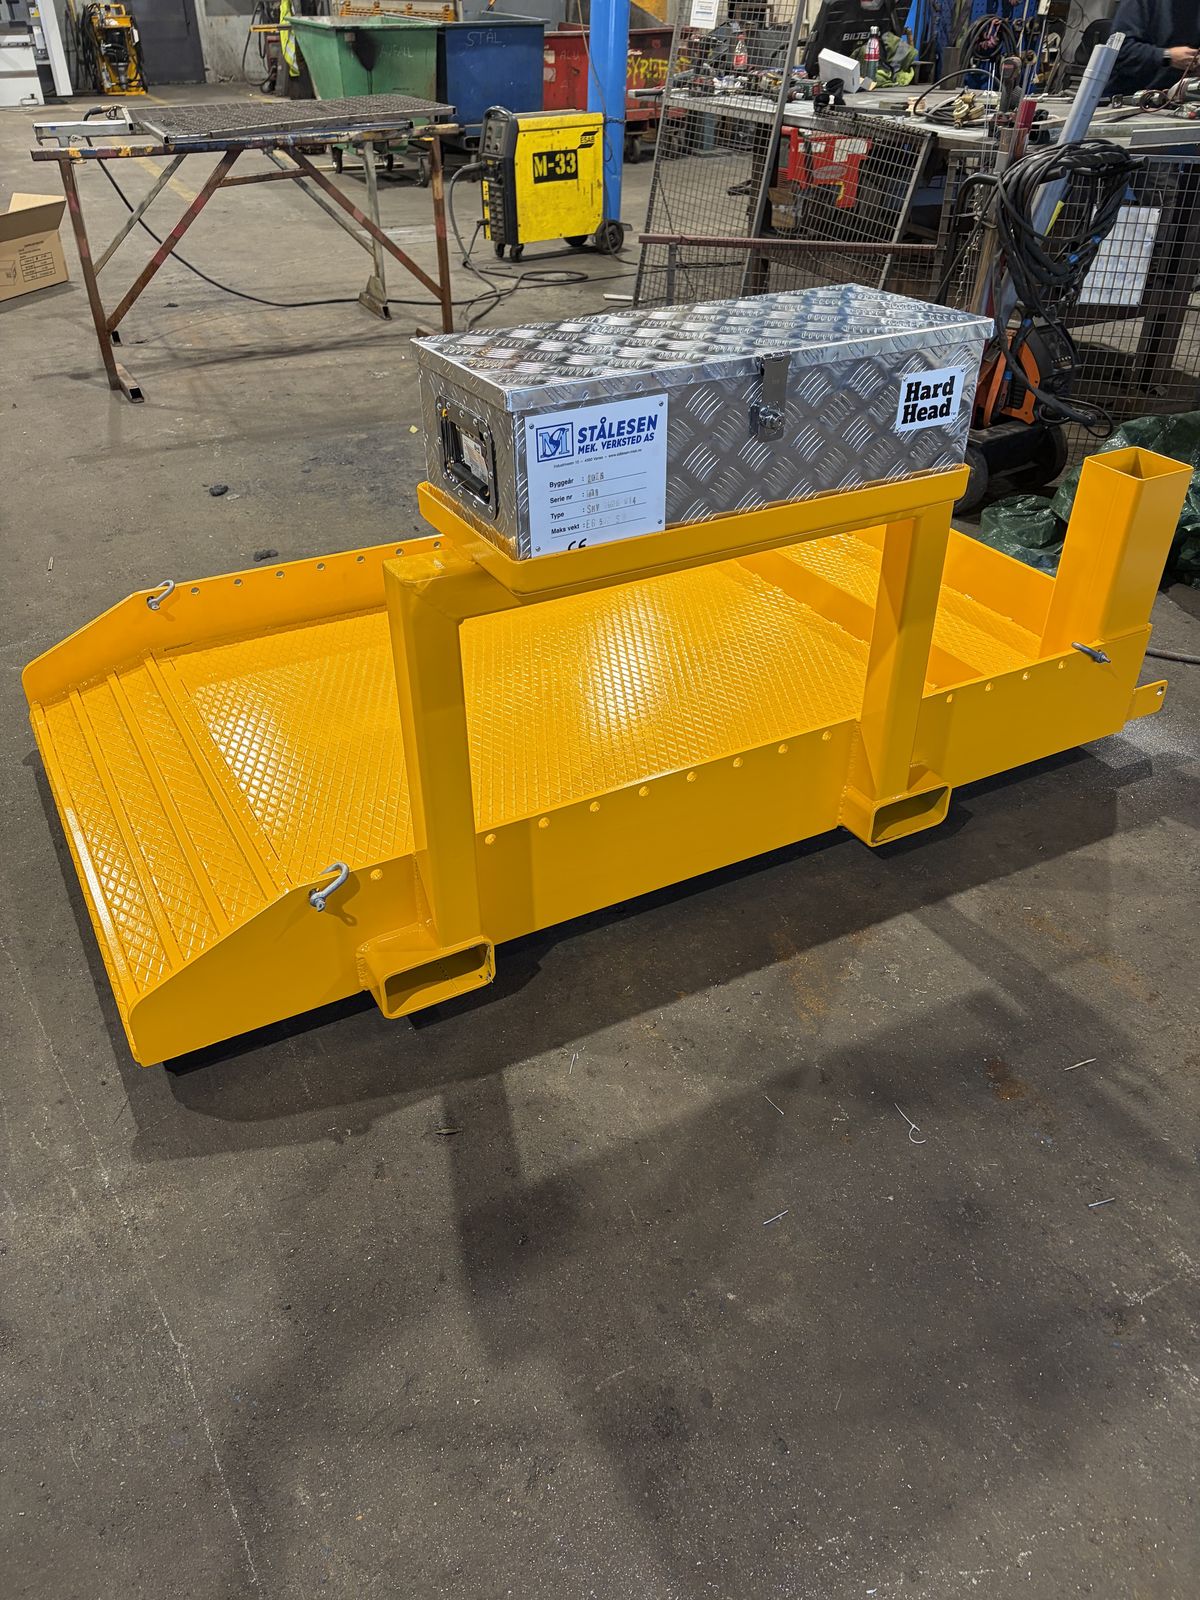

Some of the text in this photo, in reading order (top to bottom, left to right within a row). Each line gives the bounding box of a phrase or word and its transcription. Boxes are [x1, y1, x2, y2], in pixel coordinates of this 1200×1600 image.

[842, 31, 872, 41] BILTE
[534, 152, 577, 178] M-33
[904, 375, 956, 403] Hard
[901, 397, 952, 425] Head
[577, 414, 658, 444] STÅLESEN
[577, 432, 655, 455] MEK. VERKSTED AS
[549, 478, 574, 488] Byggeår
[549, 495, 565, 504] Serie
[550, 511, 565, 520] Type
[551, 526, 566, 535] Maks
[567, 524, 580, 532] vekt
